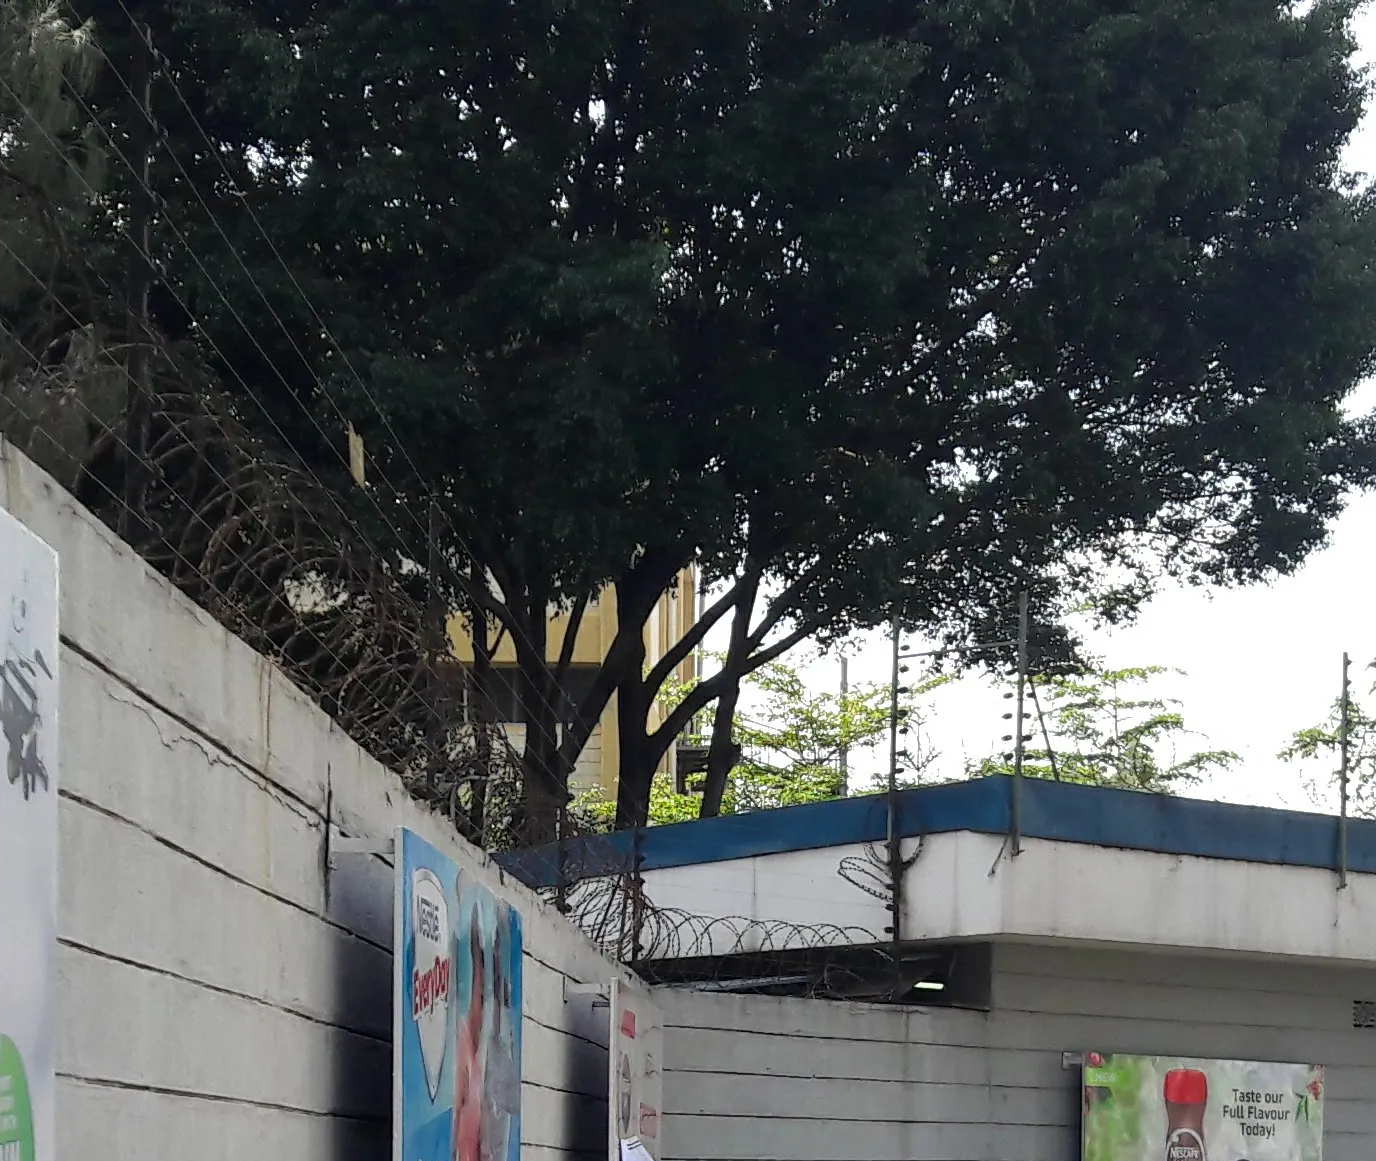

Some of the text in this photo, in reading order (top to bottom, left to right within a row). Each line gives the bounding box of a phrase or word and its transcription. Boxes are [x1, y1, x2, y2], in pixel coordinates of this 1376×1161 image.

[1232, 1088, 1284, 1104] Taste our
[1223, 1104, 1291, 1121] Full Flavour
[1239, 1122, 1276, 1140] Today!
